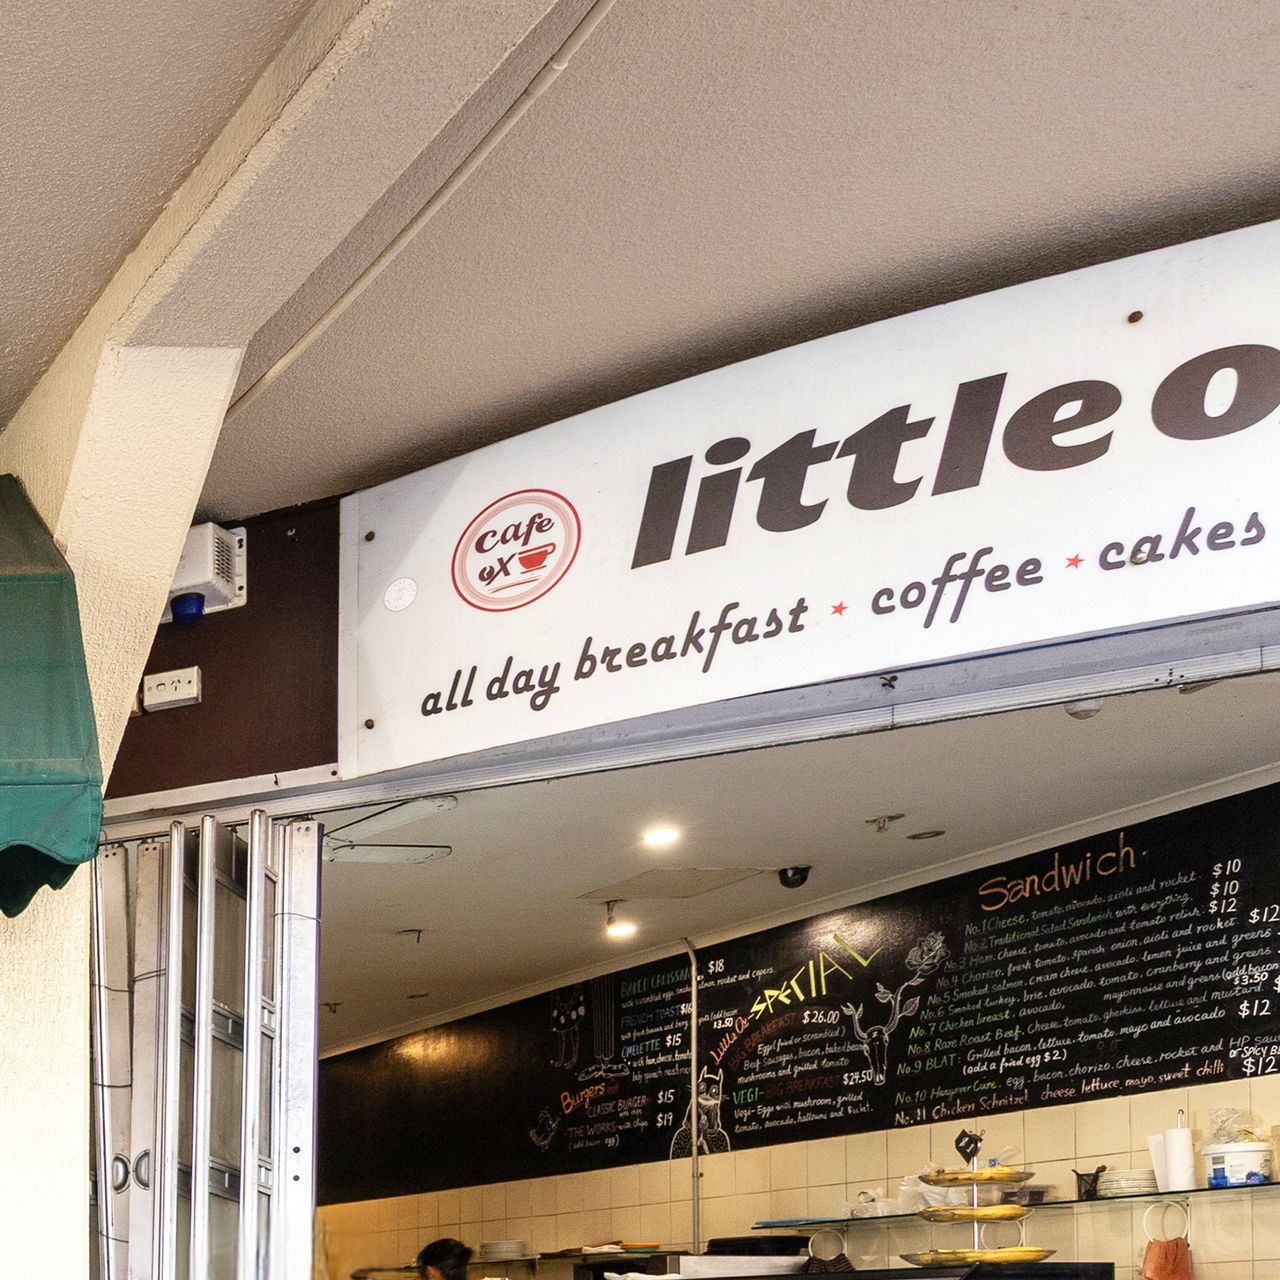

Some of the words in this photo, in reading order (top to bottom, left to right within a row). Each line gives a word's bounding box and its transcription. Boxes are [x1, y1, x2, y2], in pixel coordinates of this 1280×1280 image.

[631, 371, 1123, 570] little
[421, 667, 478, 717] all
[485, 655, 564, 713] day
[573, 595, 812, 682] breakfast
[871, 545, 1047, 632] coffee
[1098, 506, 1267, 573] cakes
[978, 832, 1136, 911] Sandwich
[1136, 879, 1156, 894] and
[1068, 908, 1113, 930] Sandwich
[1115, 904, 1136, 918] with
[1108, 926, 1126, 937] and
[1129, 916, 1166, 931] tomato
[1208, 898, 1237, 914] $12
[954, 982, 989, 1000] Smoked
[1029, 974, 1057, 985] cream
[1143, 949, 1173, 962] lemon
[1176, 941, 1202, 959] juice
[1206, 935, 1227, 949] and
[1232, 929, 1272, 946] greens
[1008, 962, 1031, 977] fresh
[1172, 925, 1191, 937] and
[708, 959, 725, 975] $18
[750, 933, 884, 1020] SPECIAL
[949, 1000, 981, 1014] Smoked
[1146, 960, 1202, 977] cranberry
[1205, 950, 1229, 964] and
[1232, 947, 1272, 962] greens
[1233, 972, 1269, 985] $3.50
[802, 1010, 840, 1025] $26.00
[939, 1016, 975, 1033] Chicken
[1103, 983, 1163, 1002] mayonnaise
[1165, 976, 1186, 990] and
[934, 1036, 957, 1051] Rare
[960, 1030, 992, 1048] Roast
[1149, 998, 1184, 1012] lettuce
[1187, 994, 1207, 1006] and
[967, 1047, 1001, 1062] Grilled
[1120, 1021, 1149, 1038] mayo
[1150, 1016, 1172, 1029] and
[1174, 1010, 1226, 1024] avocado
[1238, 999, 1271, 1018] $12
[666, 1034, 682, 1047] $15
[1160, 1047, 1198, 1062] rocket
[1201, 1039, 1223, 1051] and
[1229, 1035, 1250, 1048] HP
[738, 1072, 776, 1084] mushrooms
[778, 1067, 791, 1077] and
[793, 1060, 817, 1077] grilled
[821, 1058, 849, 1068] tomato
[990, 1062, 997, 1070] a
[999, 1055, 1024, 1073] fried
[1026, 1055, 1041, 1068] egg
[843, 1070, 873, 1086] $24.50
[932, 1099, 975, 1120] Chicken
[979, 1090, 1028, 1110] Schnitzel
[1158, 1063, 1191, 1084] sweet
[1196, 1060, 1224, 1075] chilli
[560, 1081, 605, 1115] Burgers
[657, 1089, 675, 1103] $15
[837, 1092, 863, 1107] grilled
[656, 1113, 673, 1128] $19
[830, 1109, 844, 1117] and
